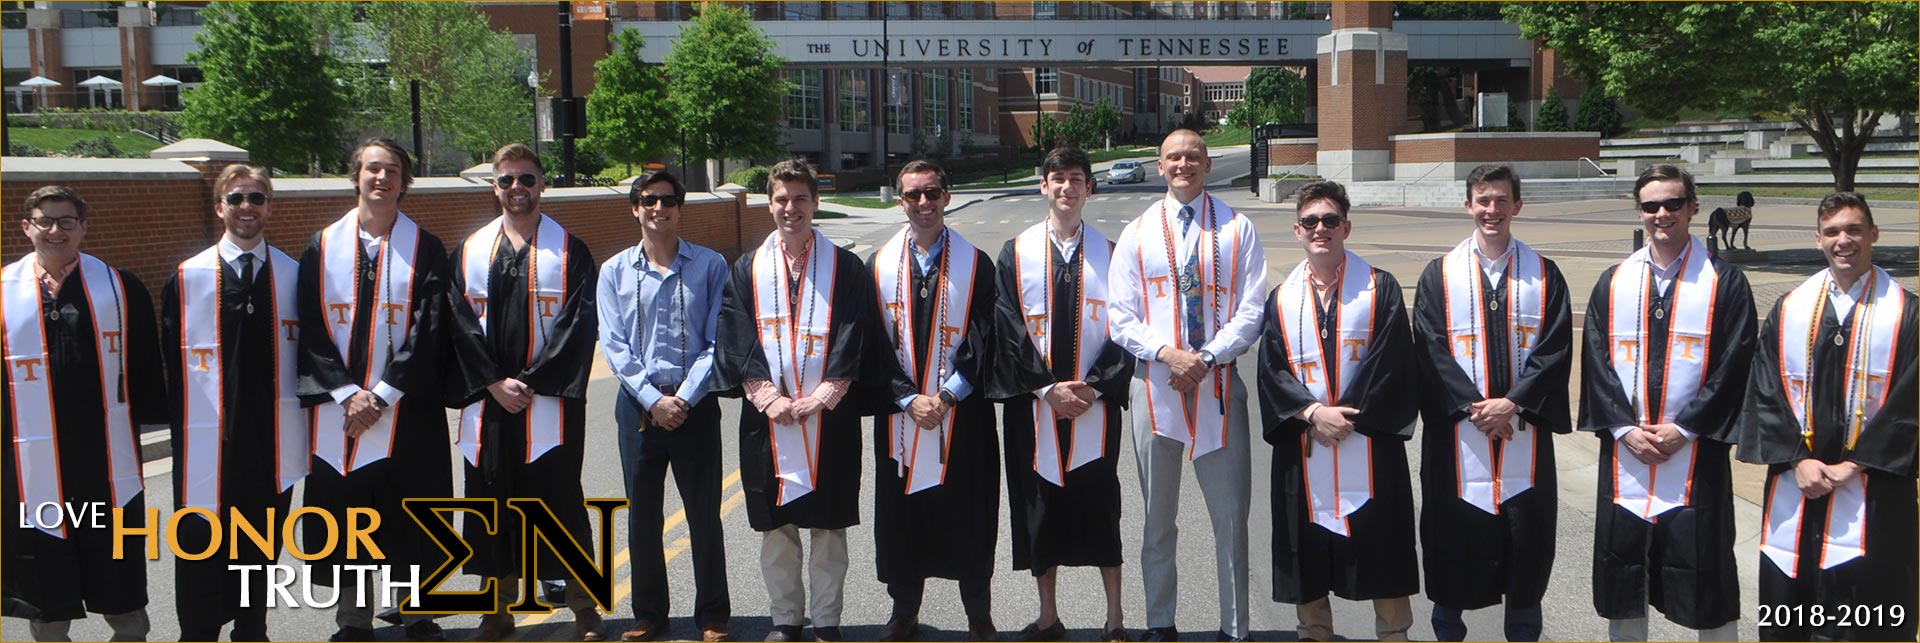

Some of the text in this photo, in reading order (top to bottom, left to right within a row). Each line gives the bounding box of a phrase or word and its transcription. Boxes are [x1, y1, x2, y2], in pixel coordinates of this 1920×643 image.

[807, 38, 1290, 57] THE UNIVERSITY of TENNESSEE
[1151, 276, 1169, 298] T
[330, 304, 351, 324] T
[381, 303, 404, 325] T
[538, 296, 558, 317] T
[1086, 298, 1105, 321] T
[764, 318, 786, 340] T
[103, 331, 121, 353] T
[1344, 338, 1365, 361] T
[1455, 334, 1478, 357] T
[1676, 335, 1701, 359] T
[16, 359, 41, 381] T
[191, 348, 214, 371] T
[1298, 361, 1318, 384] T
